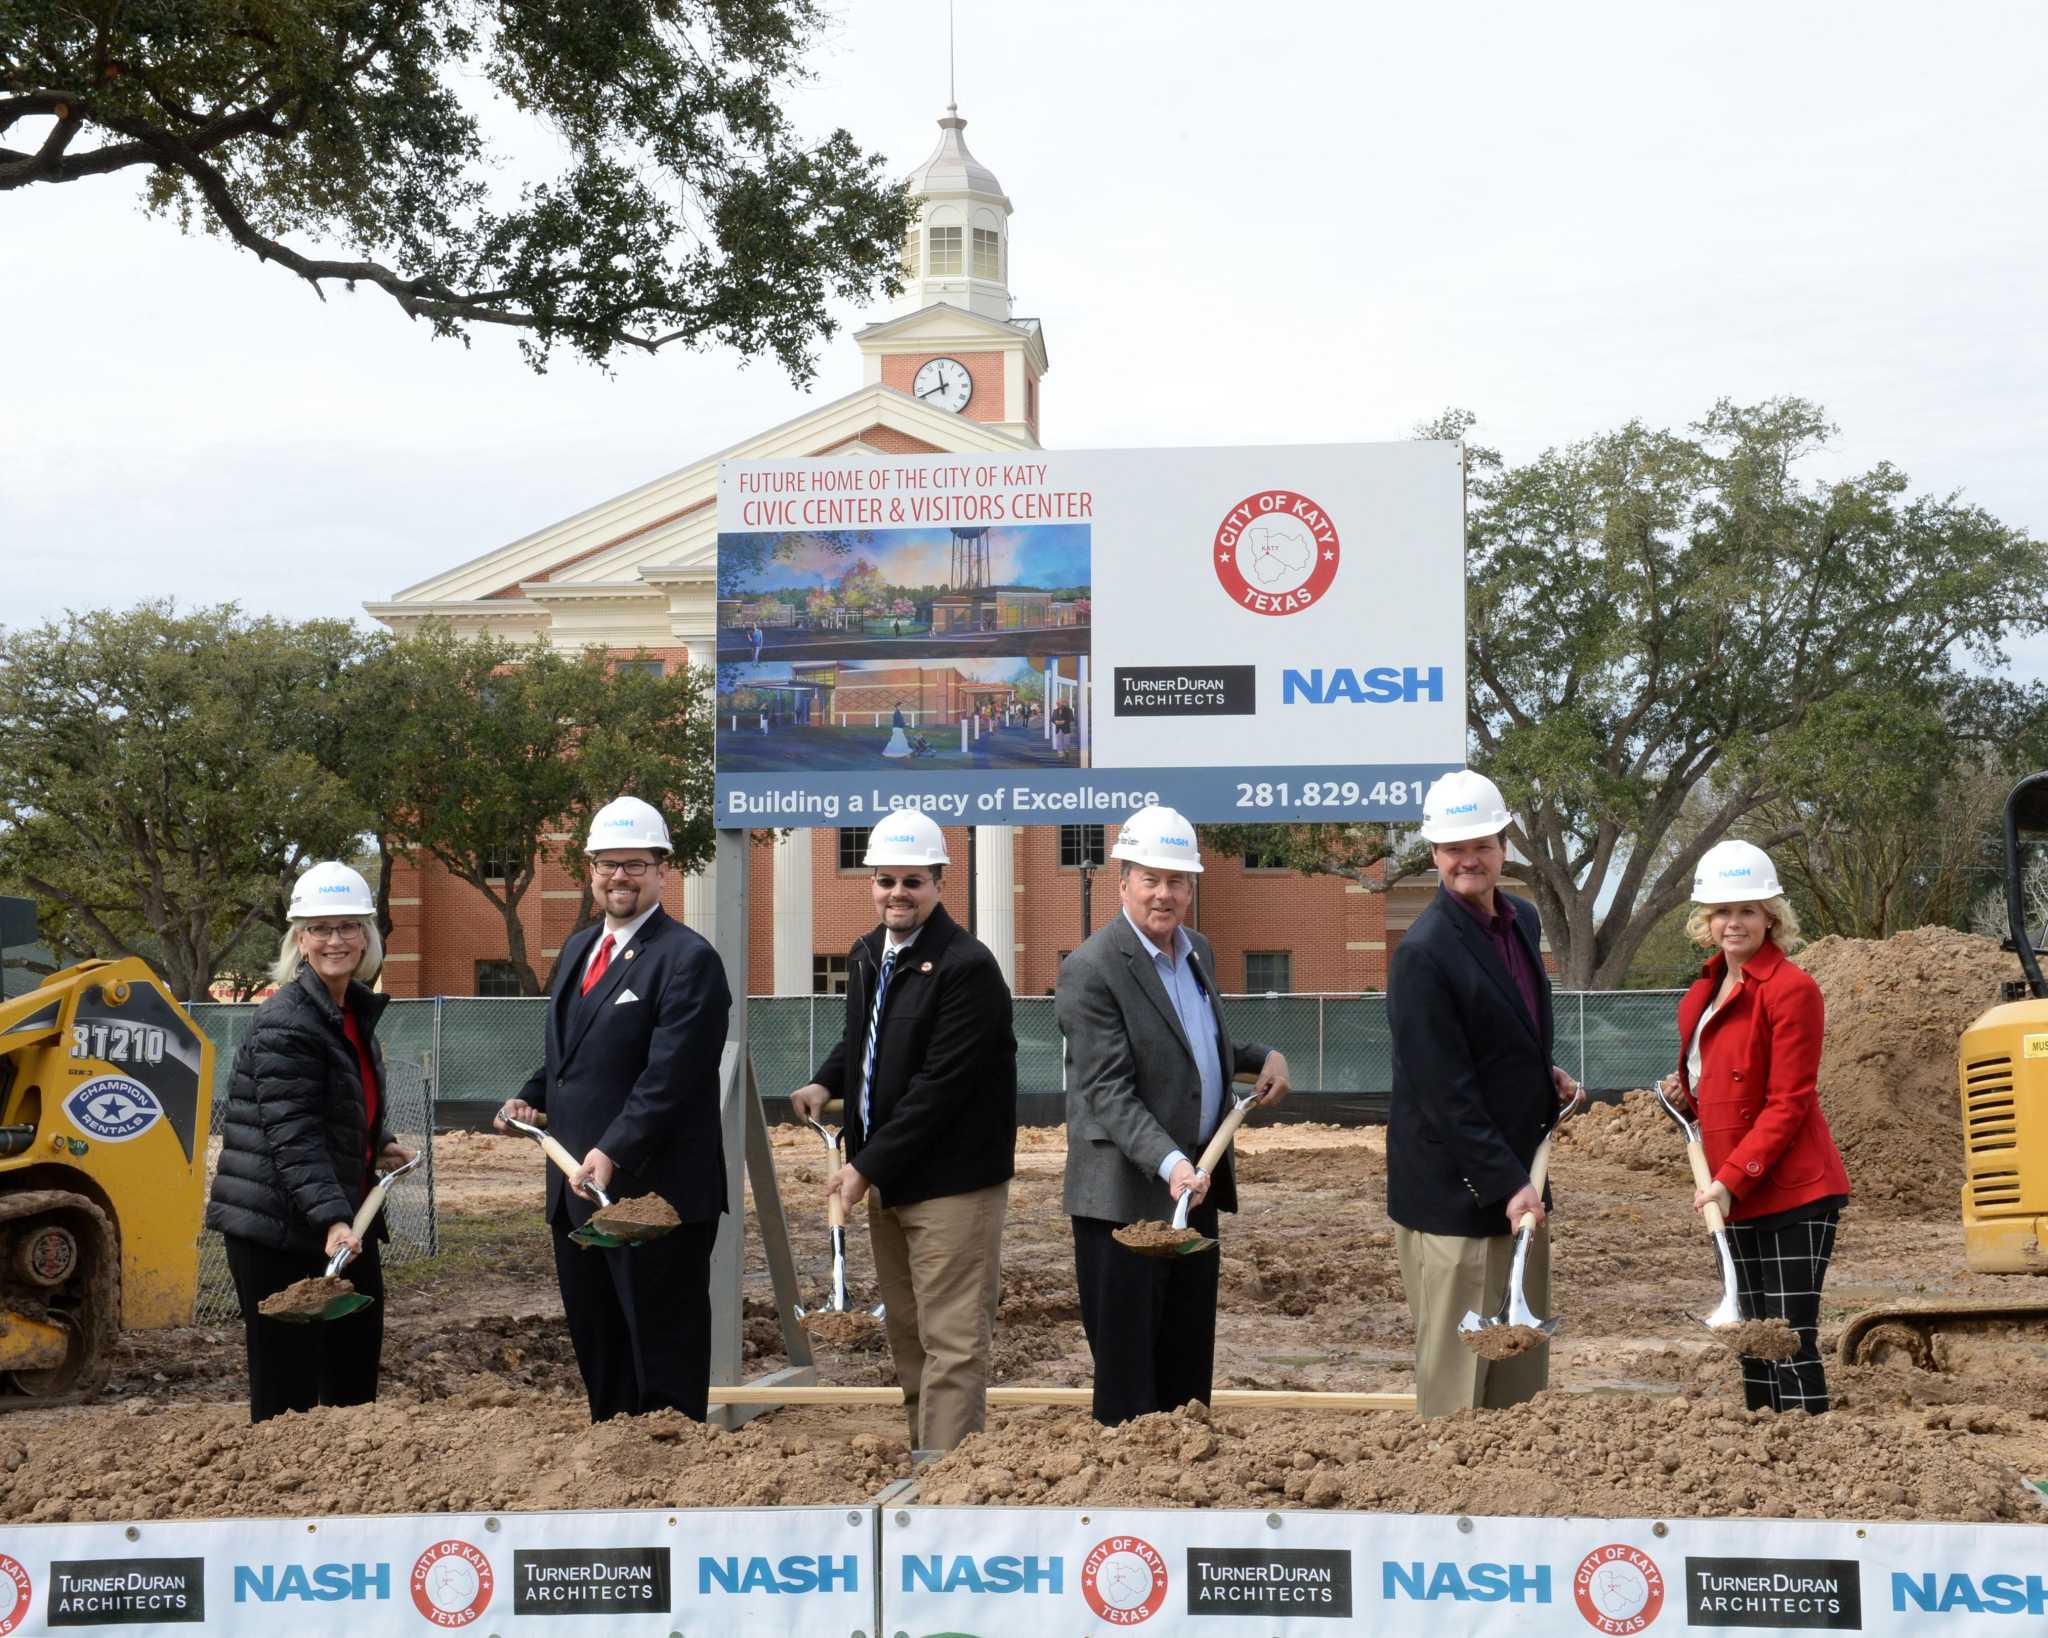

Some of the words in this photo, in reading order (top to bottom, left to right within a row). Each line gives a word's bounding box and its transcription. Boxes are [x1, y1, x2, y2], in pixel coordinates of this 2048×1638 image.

[740, 471, 805, 493] FUTURE
[812, 470, 863, 491] HOME
[869, 469, 890, 490] OF
[895, 468, 927, 489] THE
[934, 467, 970, 488] CITY
[975, 466, 997, 487] OF
[1003, 465, 1048, 486] KATY
[743, 500, 797, 526] CIVIC
[803, 498, 882, 524] CENTER
[889, 498, 905, 522] &
[911, 495, 1004, 521] VISITORS
[1011, 492, 1092, 519] CENTER
[1220, 504, 1252, 547] CITY
[1259, 495, 1287, 511] OF
[1292, 499, 1335, 543] KATY
[1244, 588, 1312, 612] TEXAS
[1283, 667, 1444, 705] NASH
[1123, 694, 1225, 706] ARCHITECTS
[729, 790, 839, 818] Building
[848, 795, 863, 812] a
[873, 790, 969, 816] Legacy
[978, 788, 1004, 811] of
[1013, 786, 1160, 811] Excellence
[1235, 781, 1437, 807] 281.829.481
[1446, 803, 1478, 815] NASH
[1160, 836, 1189, 847] NASH
[1719, 867, 1751, 877] NASH
[319, 885, 350, 894] NASH
[71, 1024, 166, 1063] RT210
[79, 1081, 149, 1106] CHAMPION
[82, 1113, 144, 1135] RENTALS
[415, 1549, 437, 1579] CITY
[441, 1543, 459, 1554] OF
[462, 1546, 490, 1577] KATY
[1086, 1545, 1108, 1575] CITY
[1112, 1539, 1132, 1551] OF
[1135, 1543, 1164, 1575] KATY
[1578, 1553, 1600, 1584] CITY
[1606, 1548, 1625, 1560] OF
[1629, 1552, 1660, 1583] KATY
[1, 1559, 29, 1588] KATY
[234, 1563, 390, 1602] NASH
[700, 1555, 858, 1594] NASH
[902, 1555, 1063, 1594] NASH
[1382, 1561, 1552, 1603] NASH
[59, 1594, 186, 1612] ARCHITECTS
[525, 1585, 653, 1601] ARCHITECTS
[1200, 1586, 1333, 1602] ARCHITECTS
[1700, 1596, 1841, 1614] ARCHITECTS
[431, 1608, 475, 1624] TEXAS
[1102, 1605, 1149, 1623] TEXAS
[1596, 1614, 1645, 1633] TEXAS
